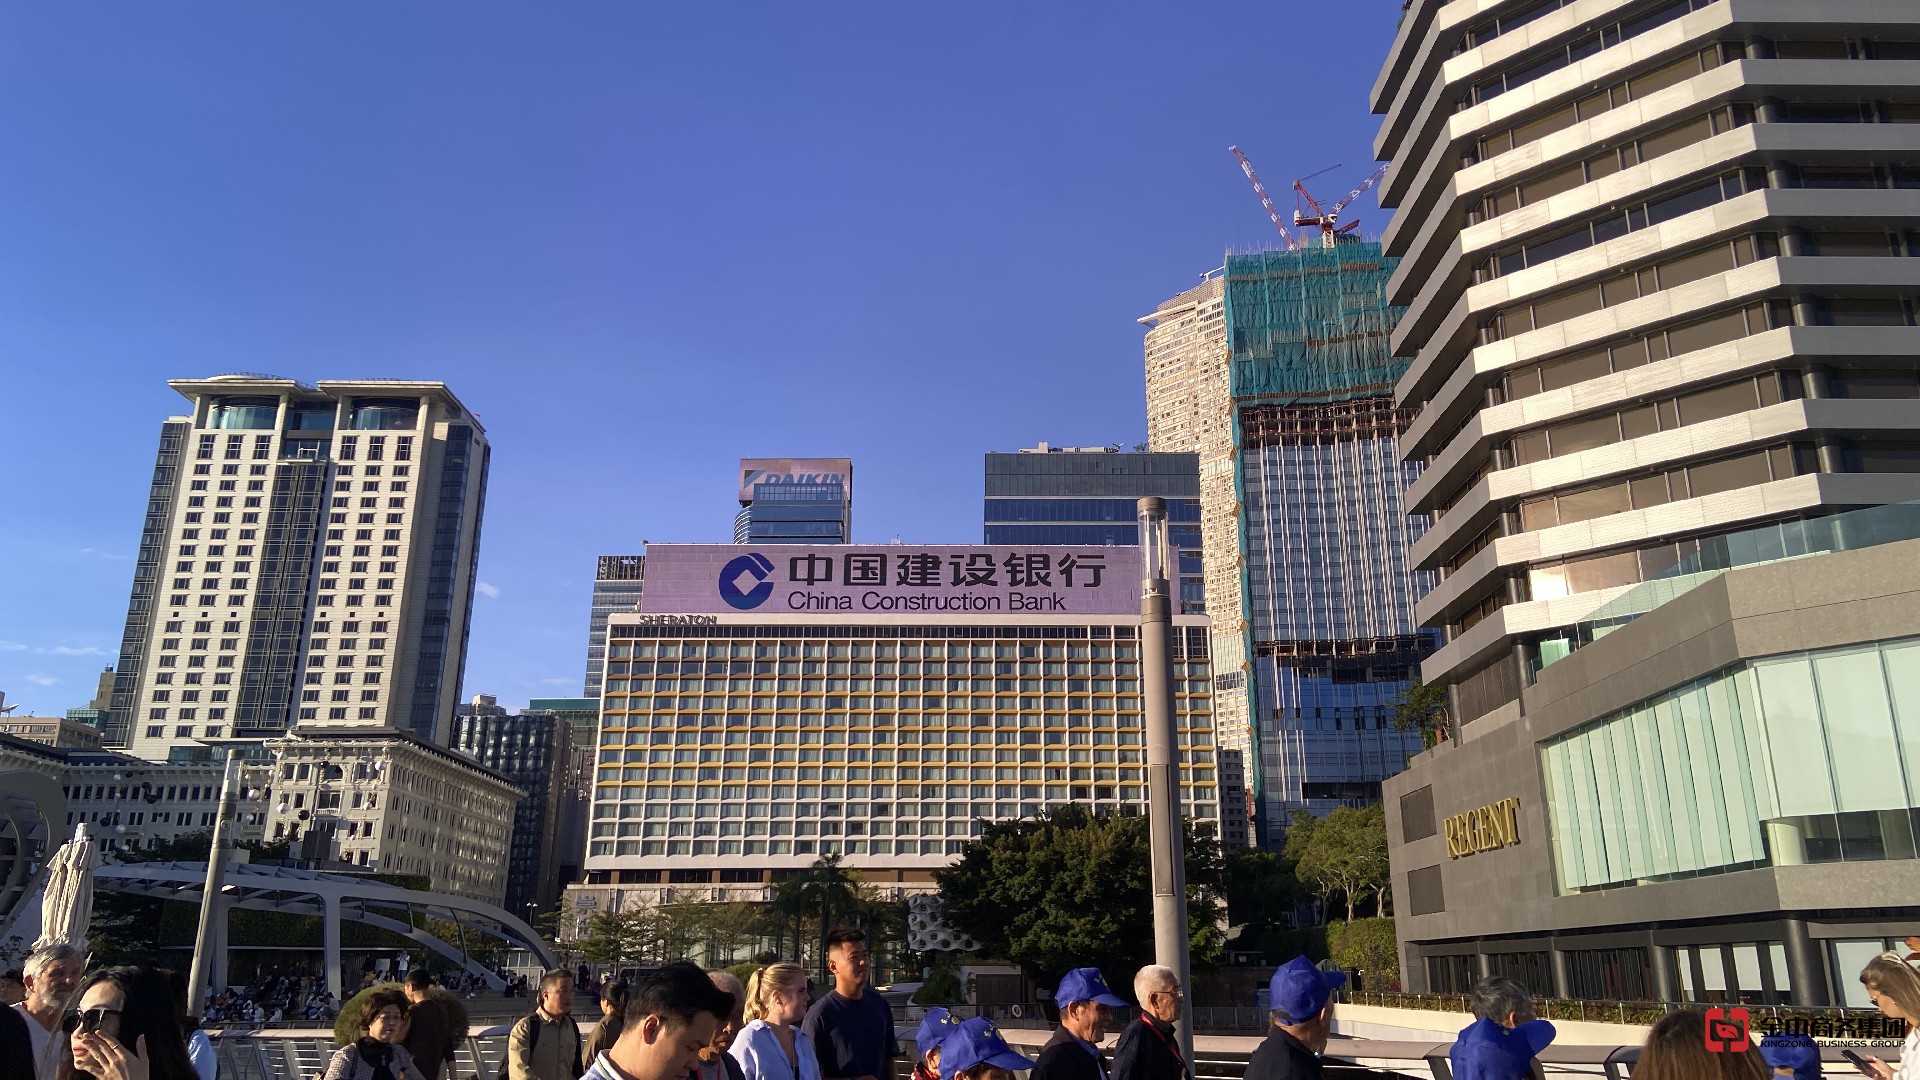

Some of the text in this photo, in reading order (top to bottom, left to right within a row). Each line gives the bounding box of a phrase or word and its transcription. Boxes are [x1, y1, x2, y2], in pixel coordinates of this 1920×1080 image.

[789, 552, 1107, 588] 中国建设银行
[787, 591, 1067, 611] China Construction Bank
[639, 614, 718, 626] SHERATON
[1442, 796, 1519, 859] REGENT
